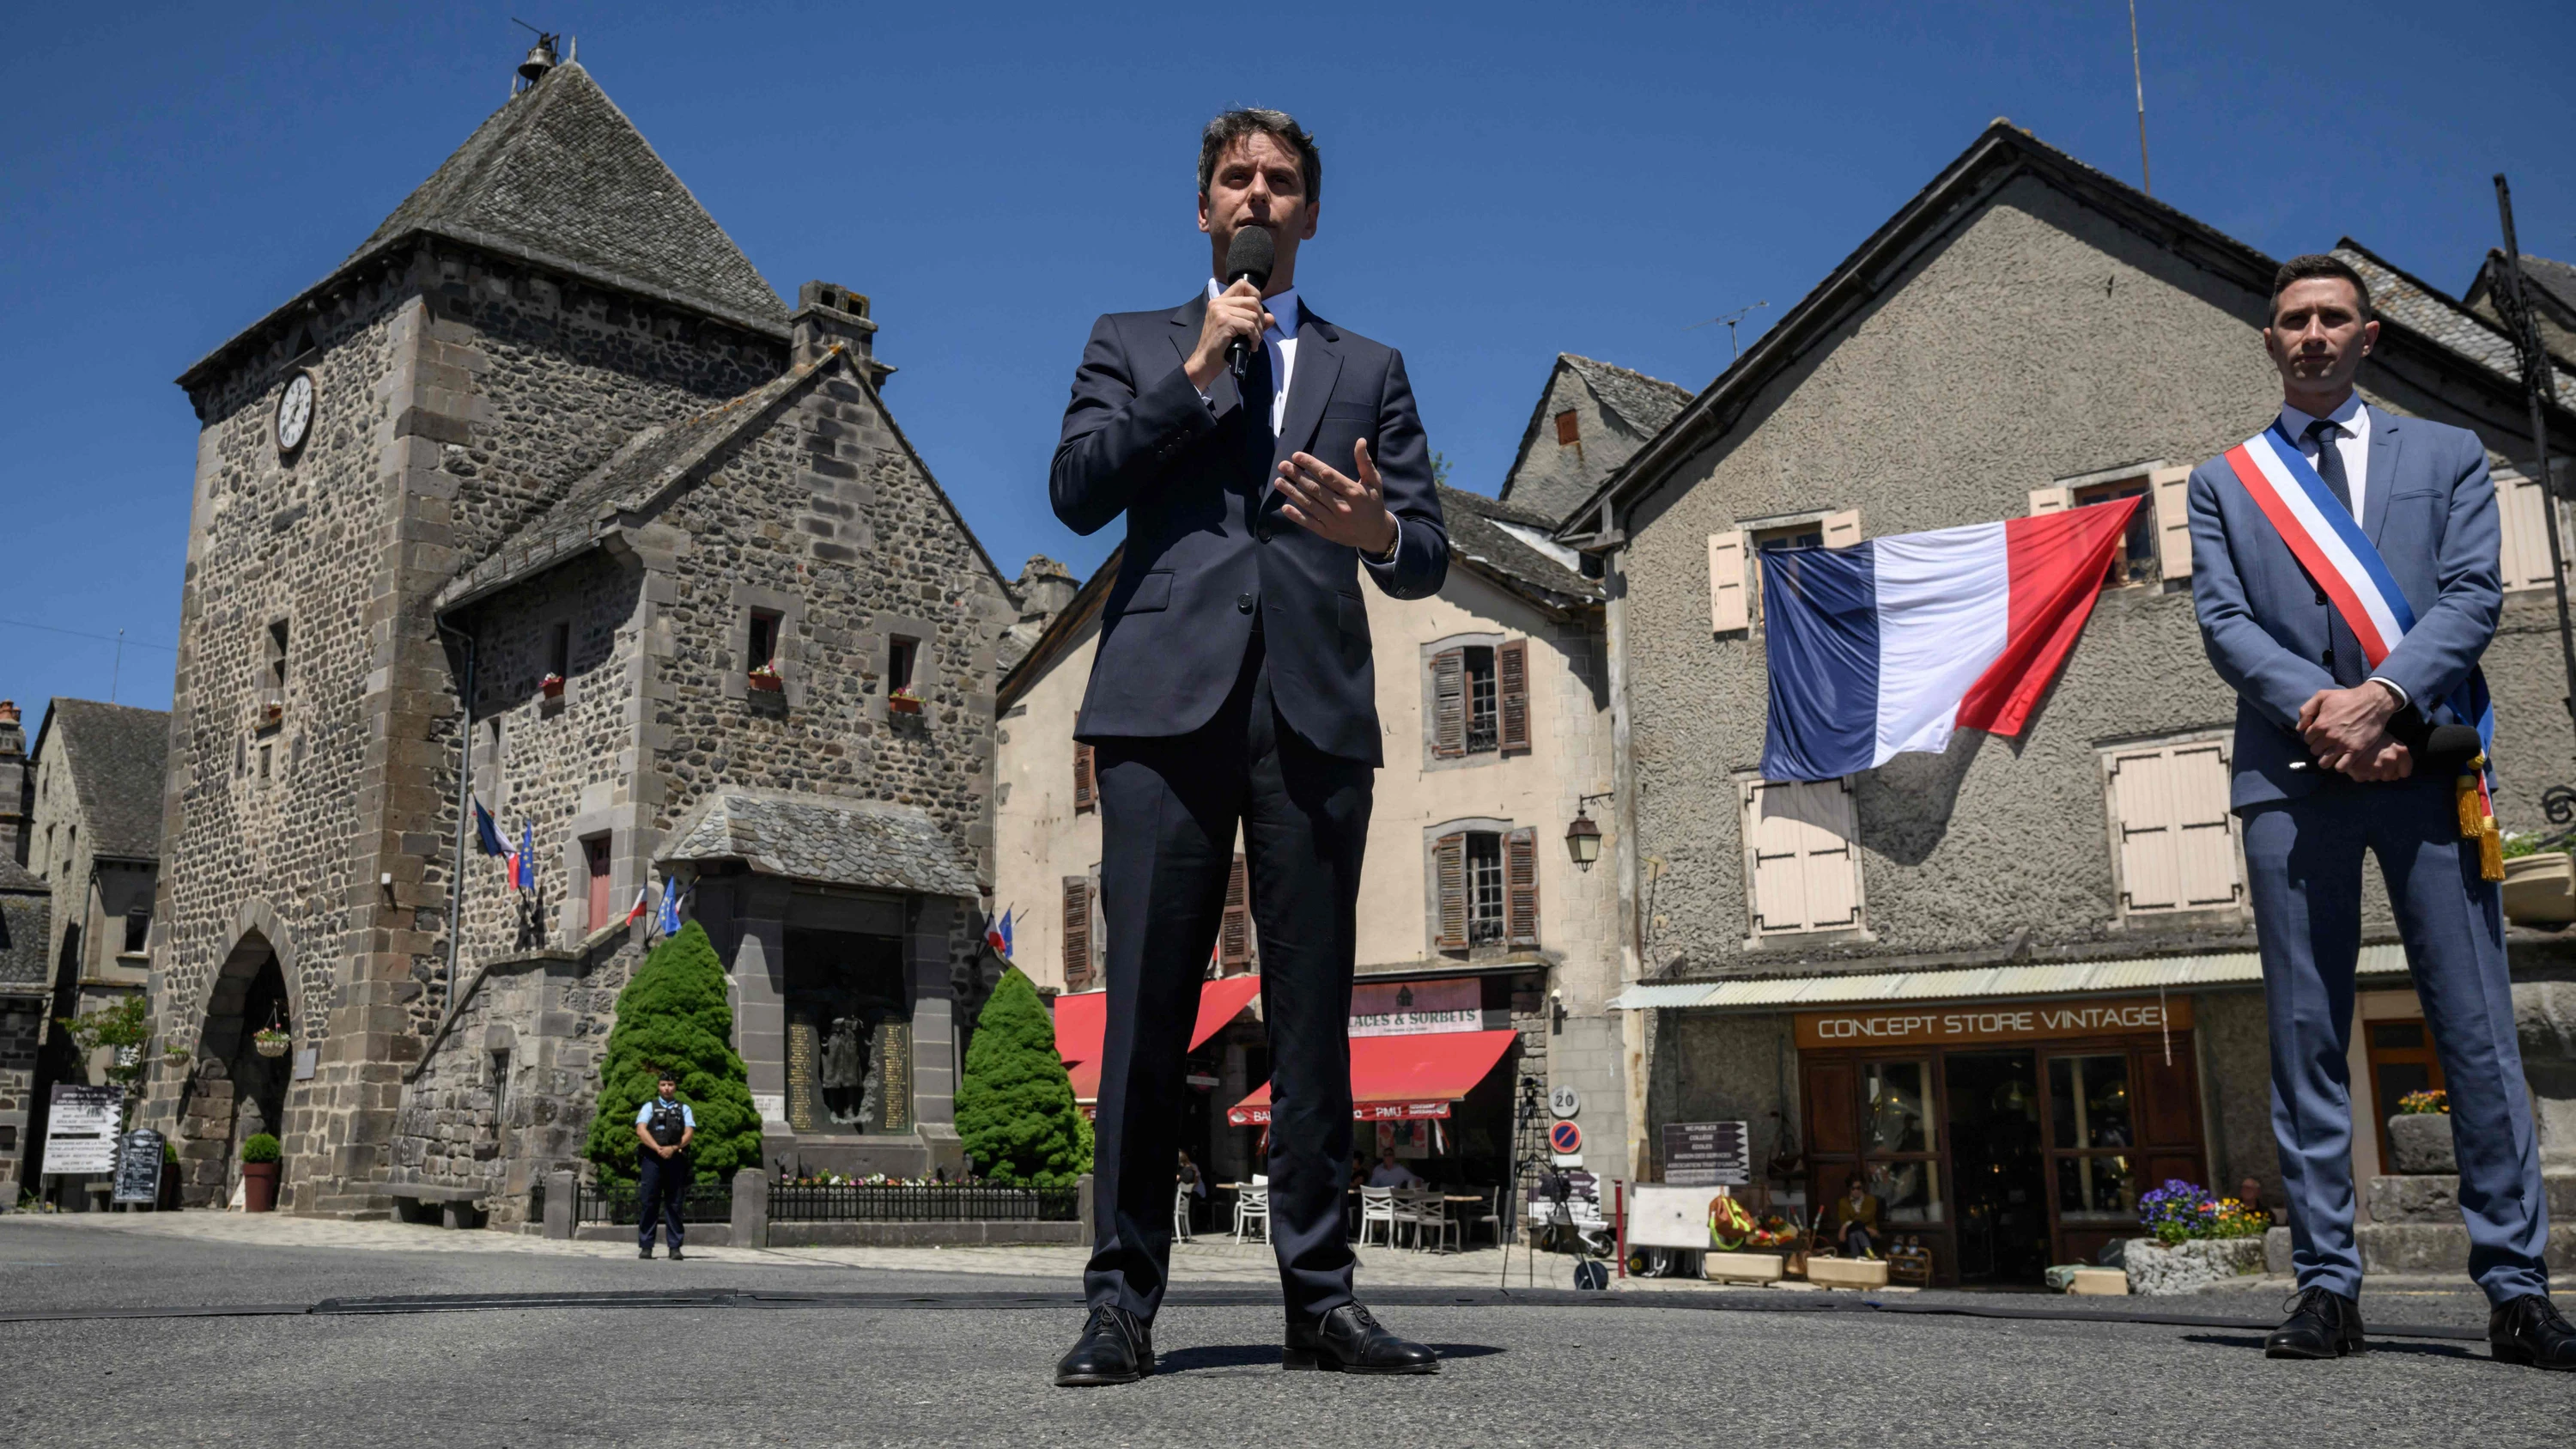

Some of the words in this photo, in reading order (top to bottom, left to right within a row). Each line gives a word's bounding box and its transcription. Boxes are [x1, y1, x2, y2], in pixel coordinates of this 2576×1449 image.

[1394, 1012, 1404, 1026] &
[1409, 1008, 1476, 1025] SORBETS
[1818, 1015, 1937, 1038] CONCEPT
[1944, 1012, 2035, 1033] STORE
[2040, 1006, 2161, 1029] VINTAGE
[1556, 1093, 1575, 1107] 20
[1376, 1106, 1401, 1117] PMU
